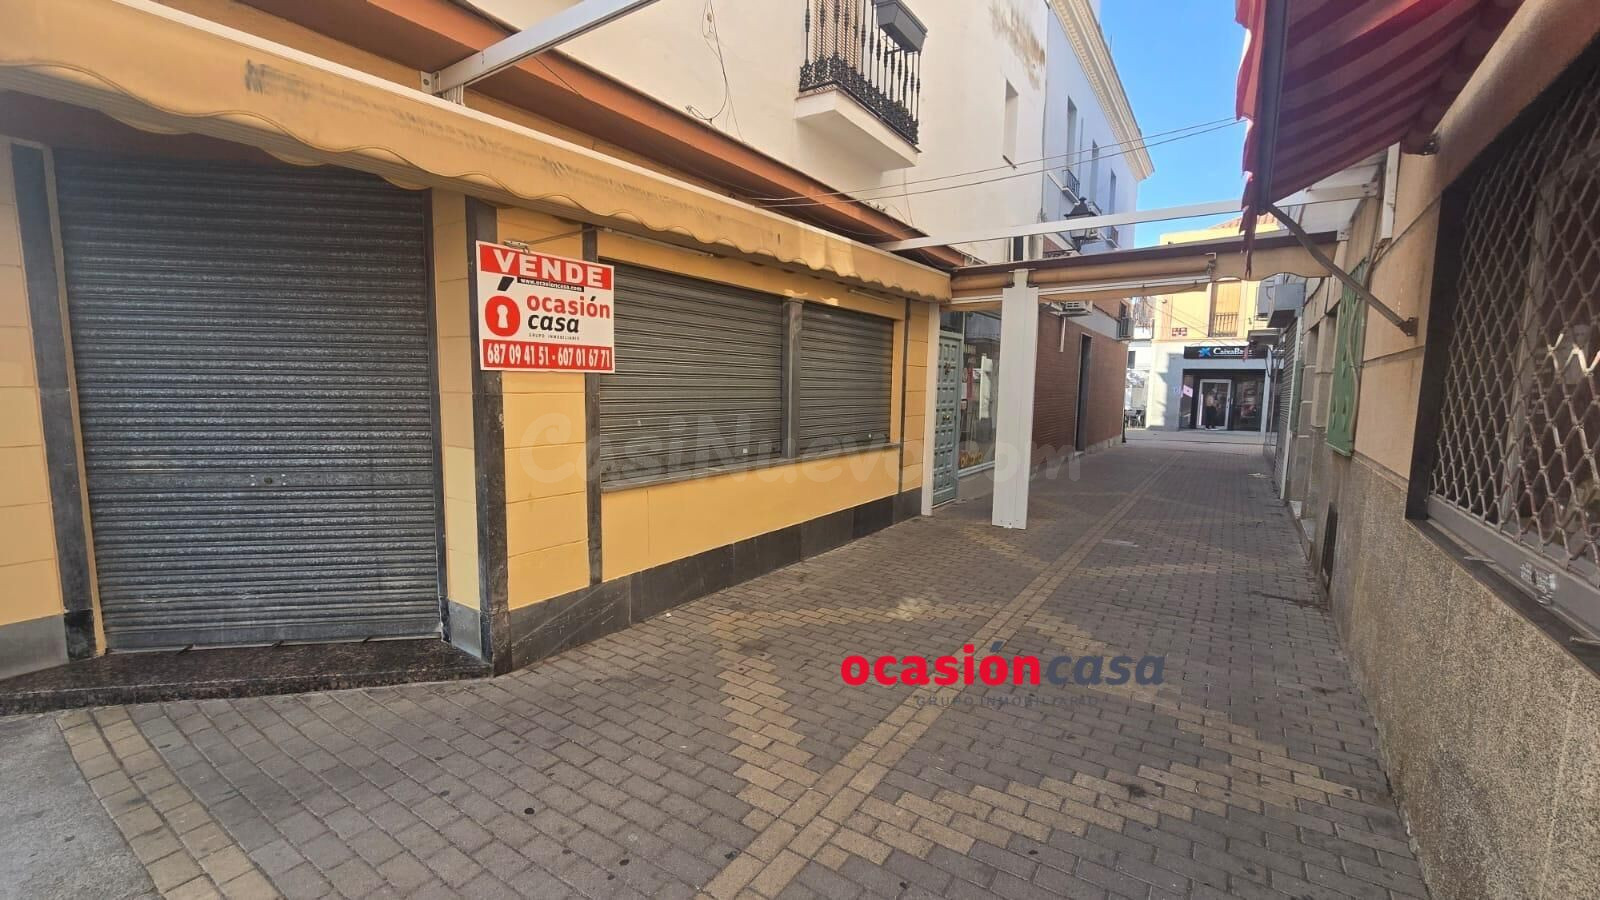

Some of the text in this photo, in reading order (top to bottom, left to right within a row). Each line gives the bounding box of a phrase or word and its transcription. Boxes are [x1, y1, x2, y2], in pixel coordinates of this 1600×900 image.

[493, 248, 603, 288] VENDE
[526, 295, 610, 319] ocasión
[528, 314, 579, 333] casa
[487, 343, 506, 364] 687
[509, 344, 522, 365] 09
[524, 345, 535, 365] 41
[538, 346, 549, 366] 51
[558, 347, 574, 367] 607
[576, 348, 586, 367] 01
[589, 349, 599, 368] 67
[601, 350, 610, 368] 71
[1213, 347, 1252, 355] CaixaBa
